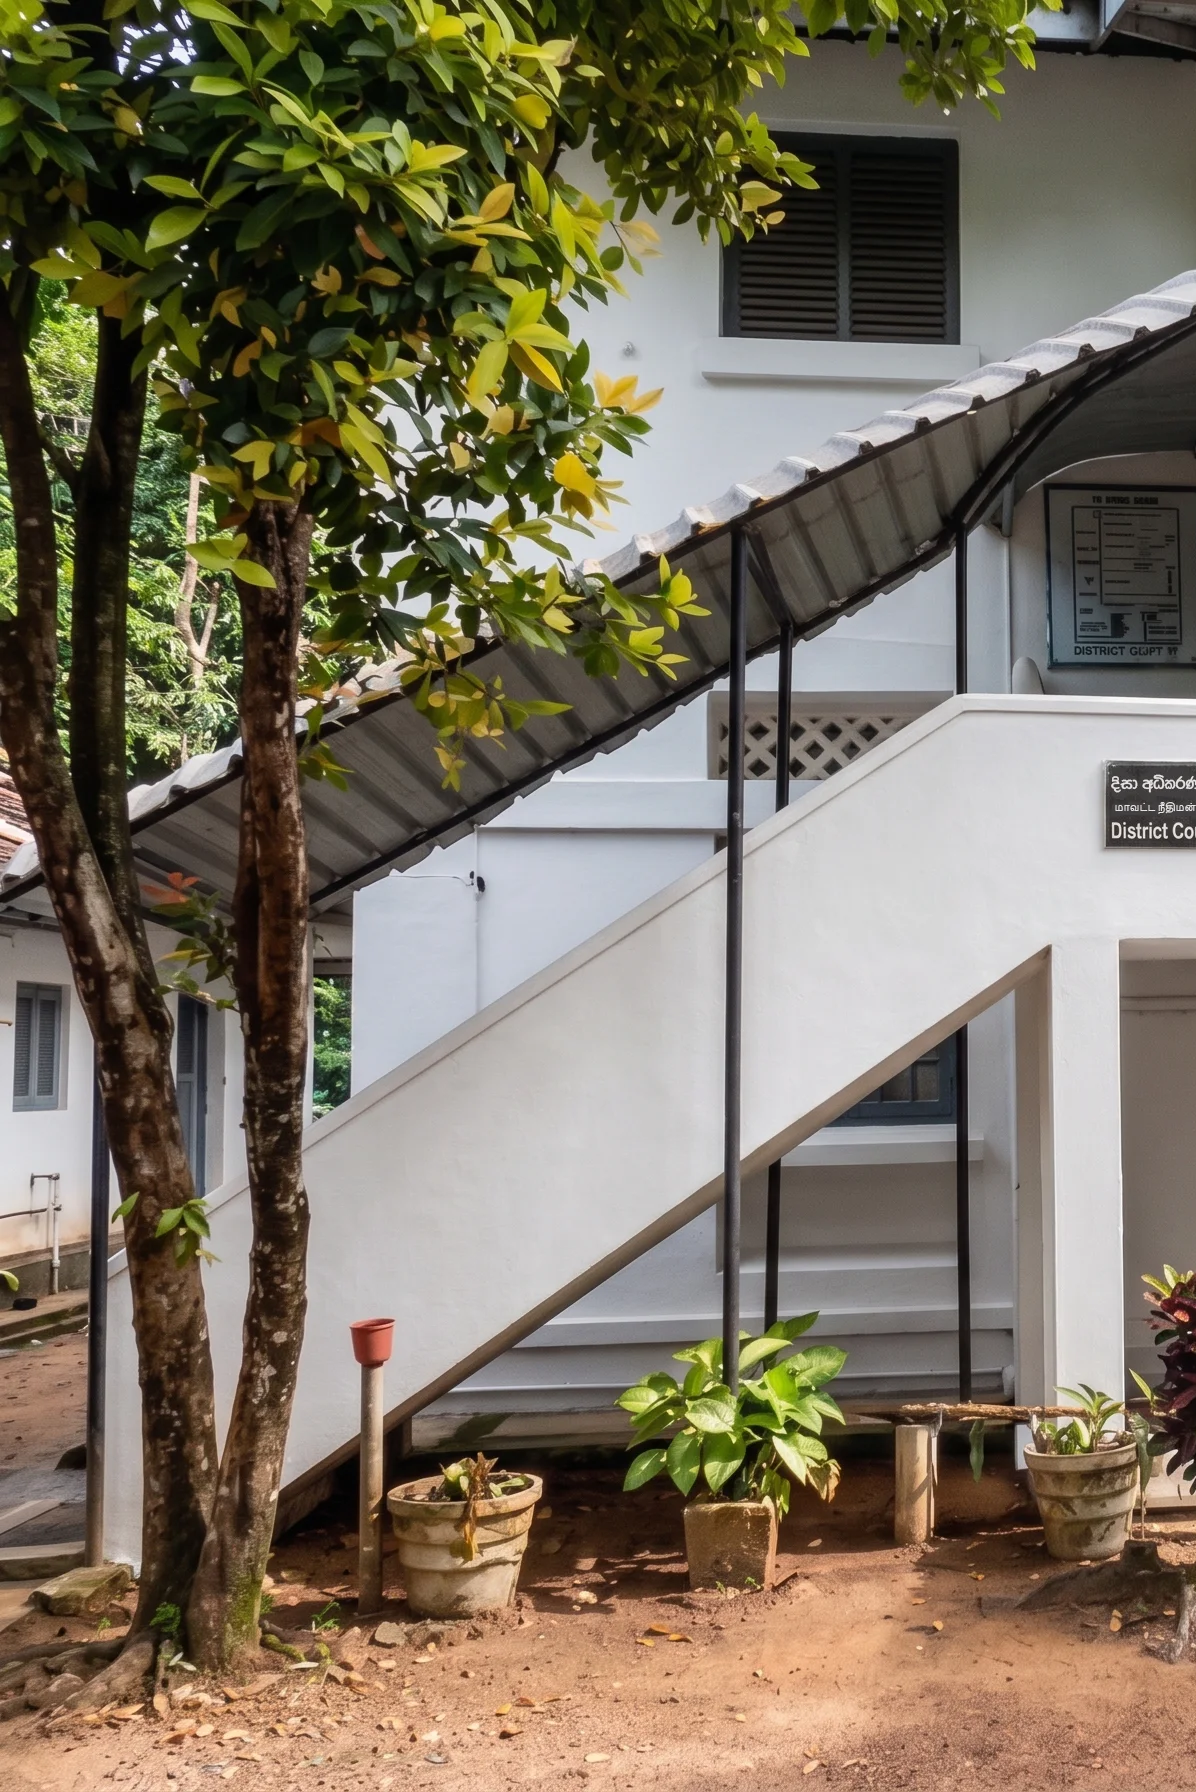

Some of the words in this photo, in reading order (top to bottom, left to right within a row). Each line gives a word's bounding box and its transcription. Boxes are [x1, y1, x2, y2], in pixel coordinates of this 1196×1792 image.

[1074, 645, 1126, 656] DISTRICT
[1114, 802, 1156, 812] மாவட்ட
[1111, 821, 1168, 840] District
